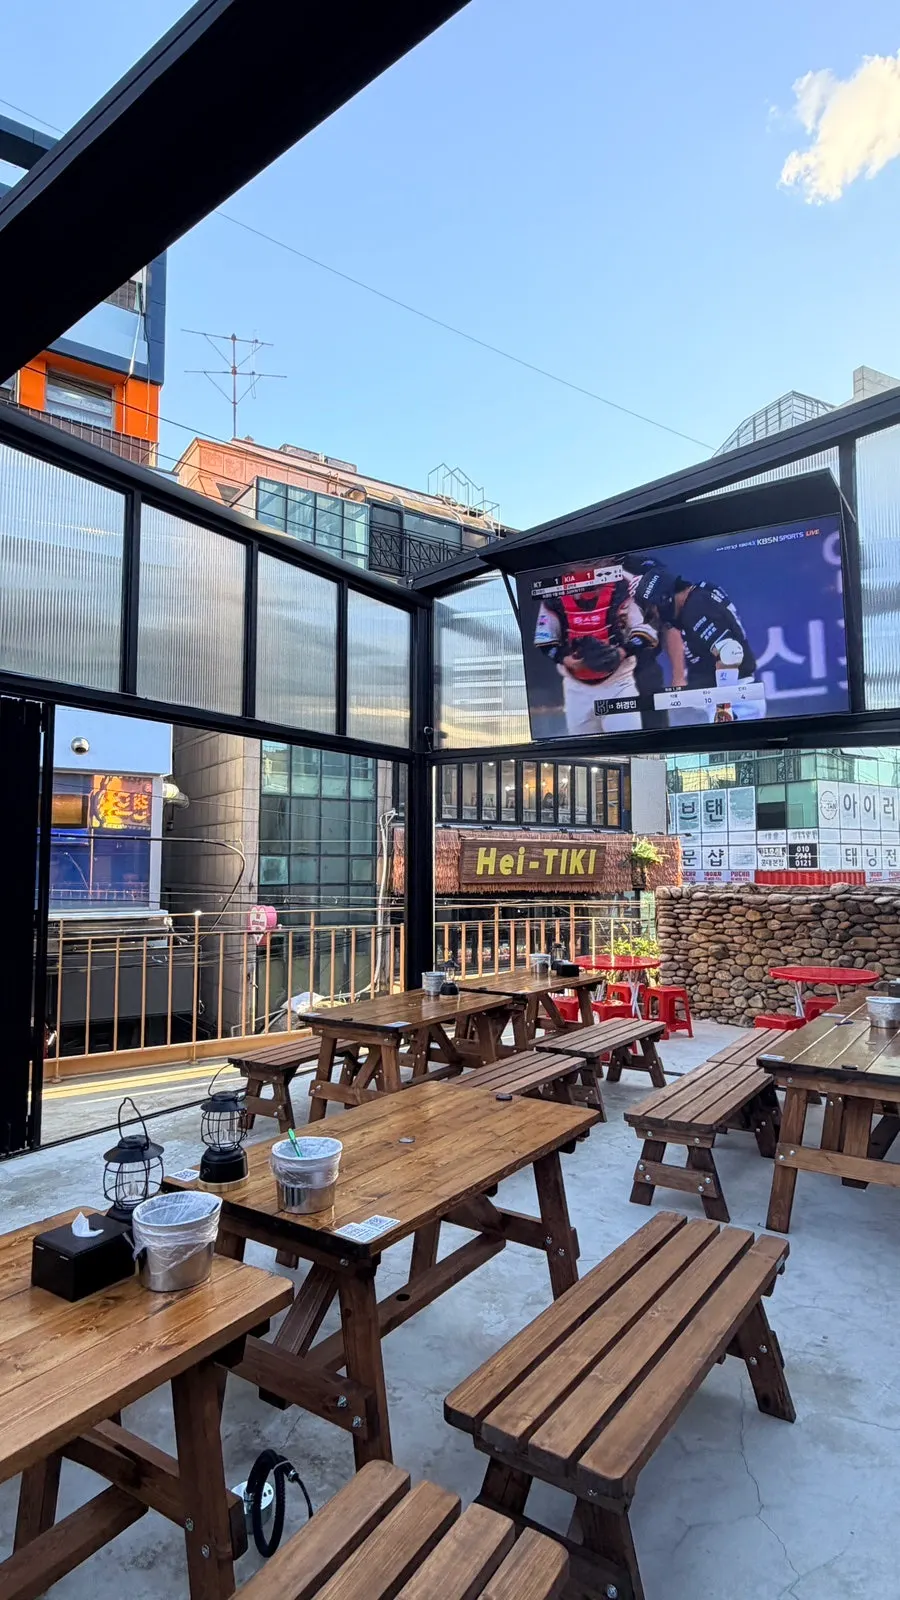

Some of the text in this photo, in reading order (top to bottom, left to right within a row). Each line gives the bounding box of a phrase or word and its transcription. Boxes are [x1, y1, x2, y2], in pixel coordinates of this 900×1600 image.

[756, 535, 779, 546] KBSN
[779, 531, 804, 542] SPORTS
[805, 528, 820, 537] LIVE
[533, 581, 543, 589] KT
[476, 846, 597, 875] Hei-TIKI
[795, 859, 812, 867] 0121
